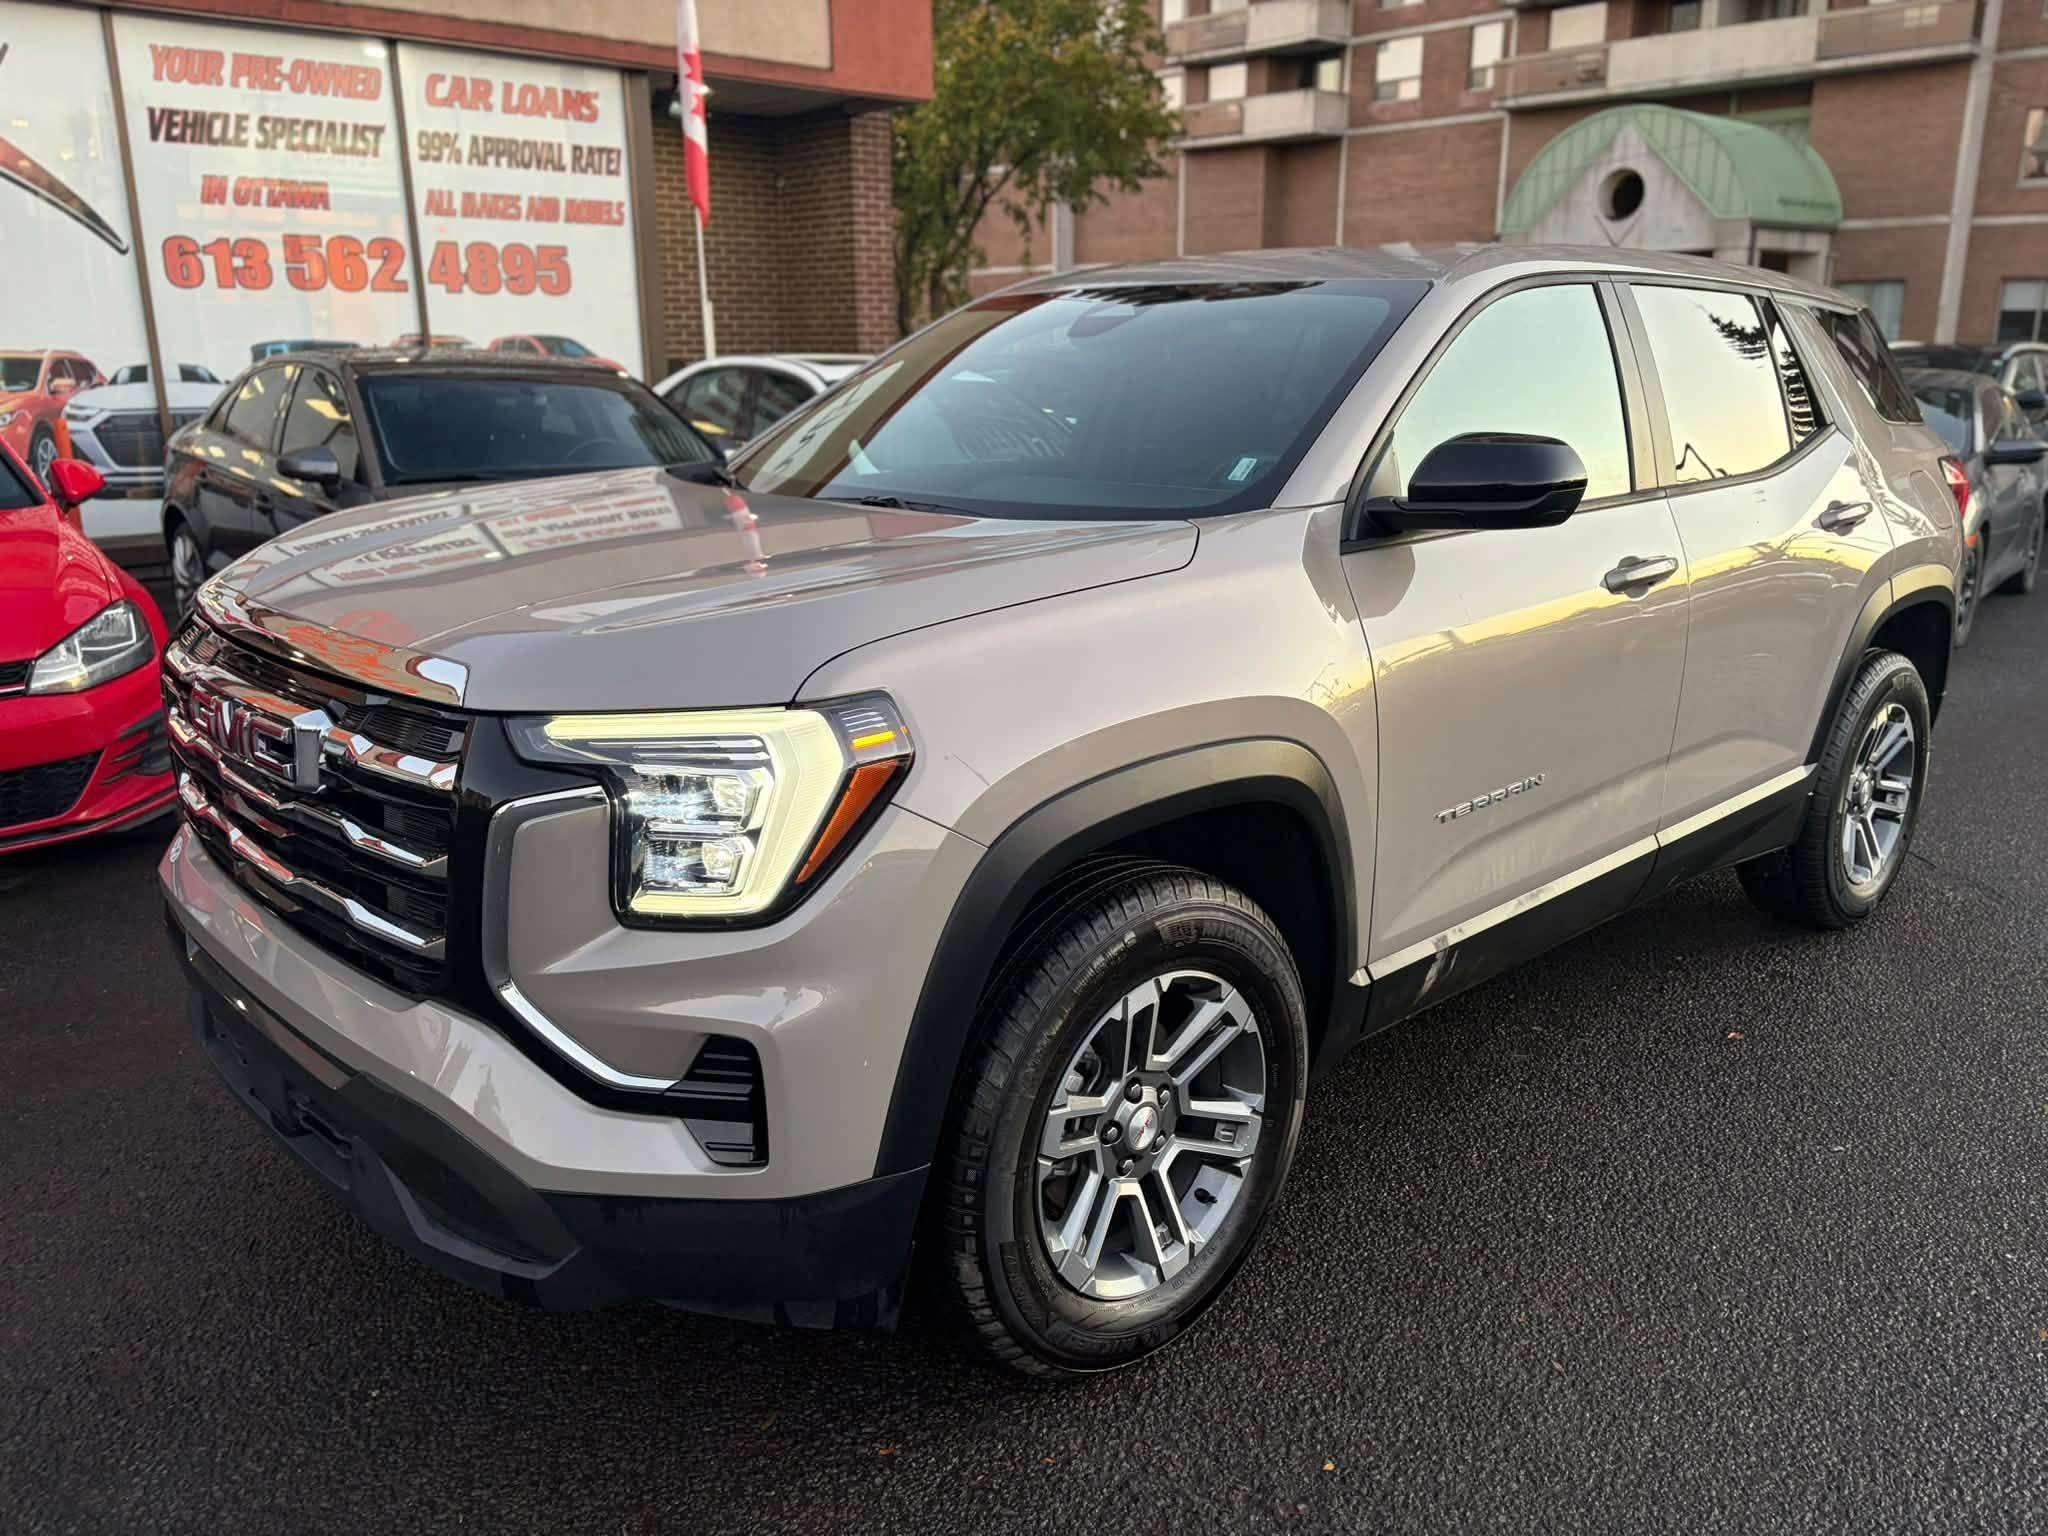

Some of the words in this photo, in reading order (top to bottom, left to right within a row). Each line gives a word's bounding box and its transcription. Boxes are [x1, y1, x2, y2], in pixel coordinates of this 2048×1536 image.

[149, 44, 225, 86] YOUR
[230, 52, 383, 101] PRE-OWNED
[425, 73, 494, 112] CAR
[502, 80, 600, 123] LOANS
[147, 106, 251, 148] VEHICLE
[255, 115, 386, 158] SPECIALIST
[417, 130, 462, 165] 99%
[467, 134, 567, 173] APPROVAL
[571, 144, 622, 177] RATE!
[201, 174, 229, 205] IN
[424, 188, 457, 217] ALL
[526, 195, 561, 223] AND
[161, 235, 274, 291] 613
[282, 233, 409, 293] 562
[427, 240, 572, 297] 4895
[191, 674, 295, 782] GMC
[1433, 770, 1547, 824] TERRAIN
